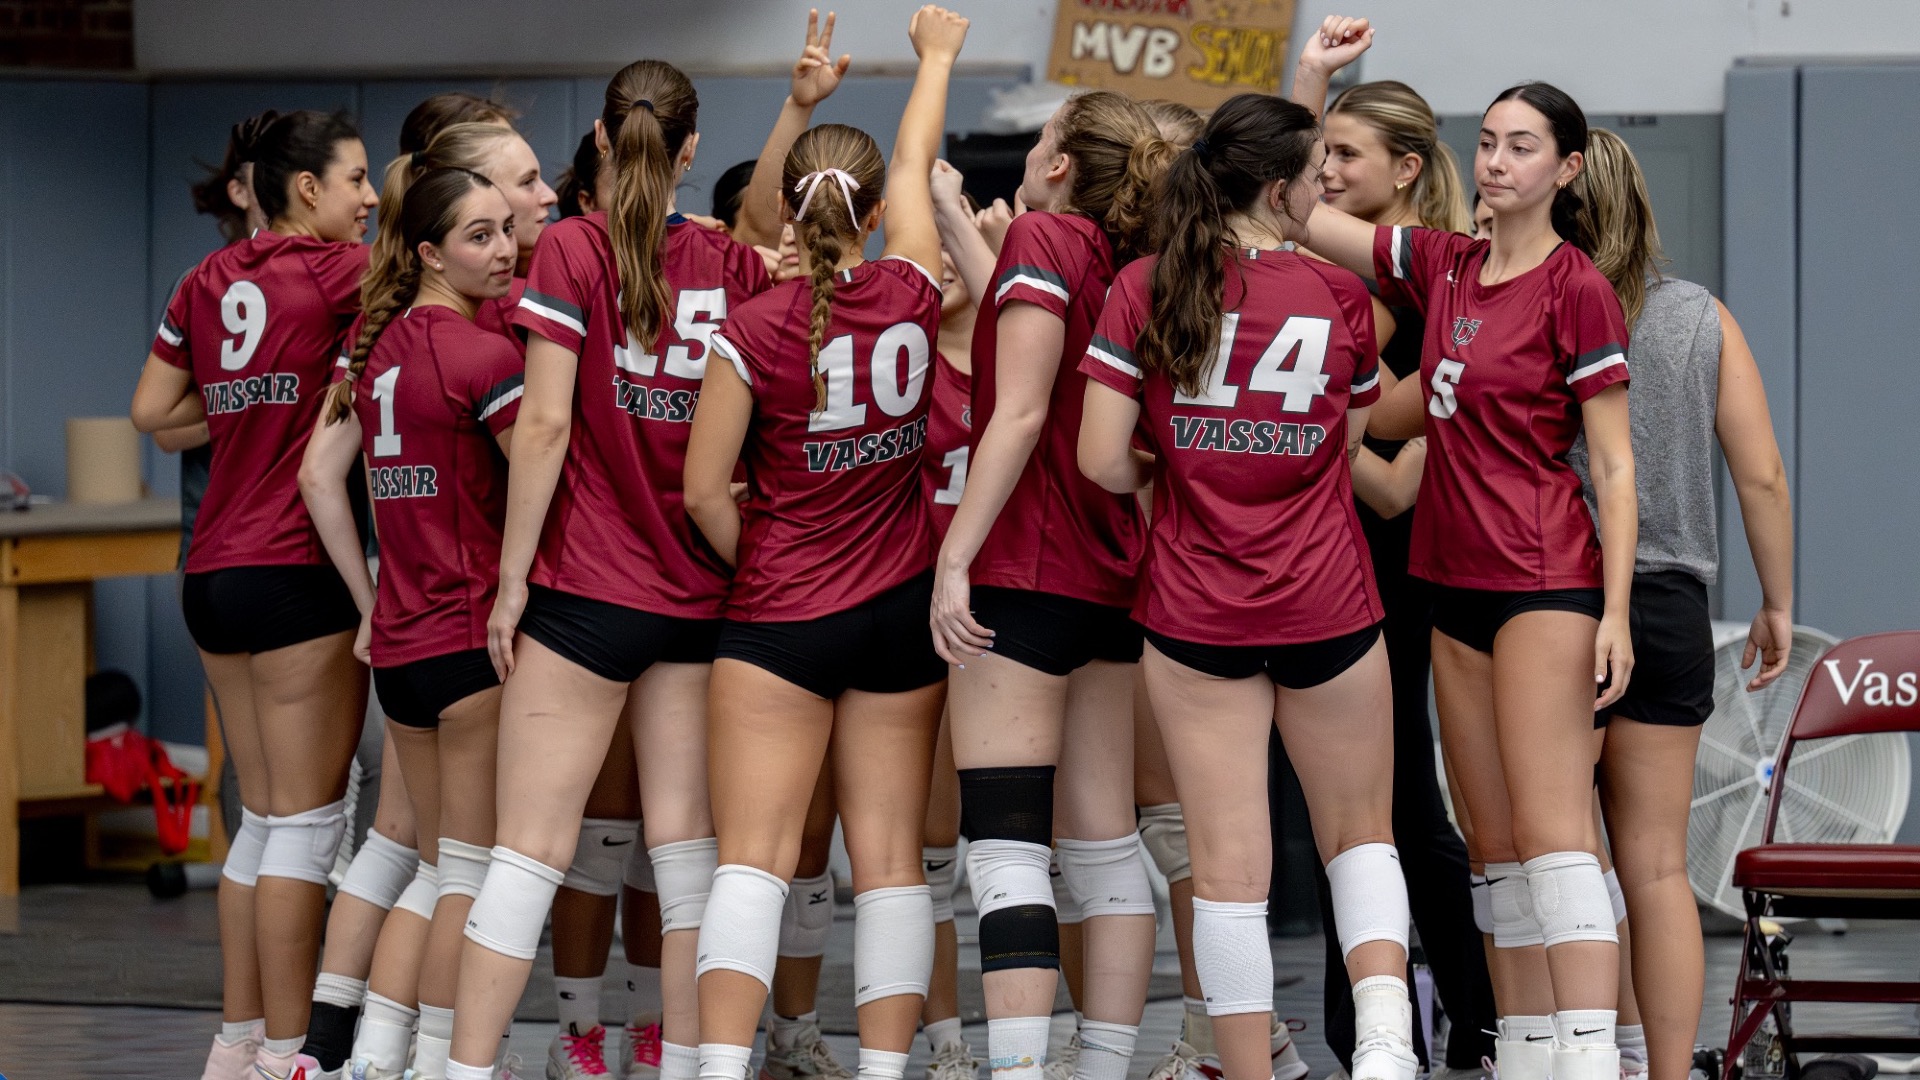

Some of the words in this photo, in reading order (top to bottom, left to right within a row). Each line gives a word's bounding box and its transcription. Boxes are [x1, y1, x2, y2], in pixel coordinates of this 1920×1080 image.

[1071, 21, 1180, 78] MVB
[220, 279, 267, 371] 9
[807, 321, 930, 432] 10
[1173, 312, 1332, 413] 14
[1429, 357, 1466, 419] 5
[203, 373, 299, 416] VASSAR
[373, 365, 402, 458] 1
[802, 414, 928, 472] VASSAR
[1170, 415, 1326, 457] VASSAR
[934, 445, 970, 506] 1
[1823, 658, 1918, 707] Vas
